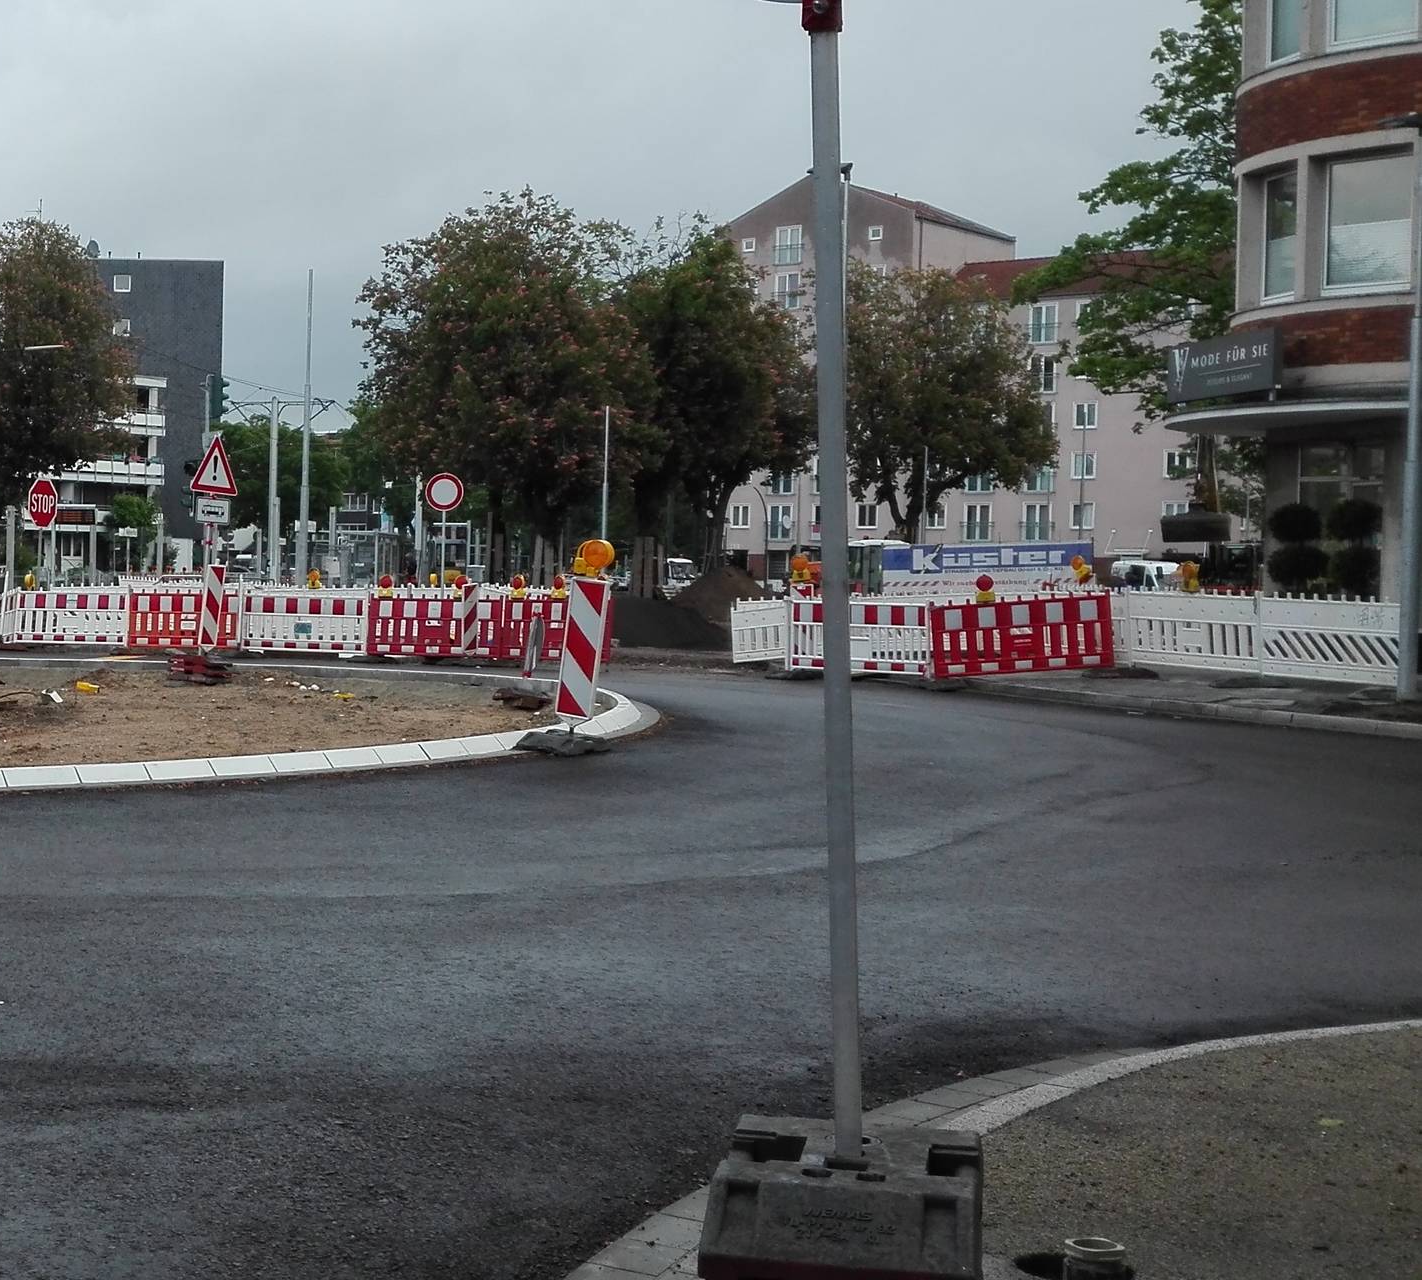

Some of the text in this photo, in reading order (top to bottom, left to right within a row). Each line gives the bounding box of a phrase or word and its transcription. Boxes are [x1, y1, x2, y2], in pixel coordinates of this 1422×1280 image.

[1191, 343, 1268, 369] MODE FÜR SIE
[30, 493, 55, 514] STOP
[913, 546, 1066, 571] Küster
